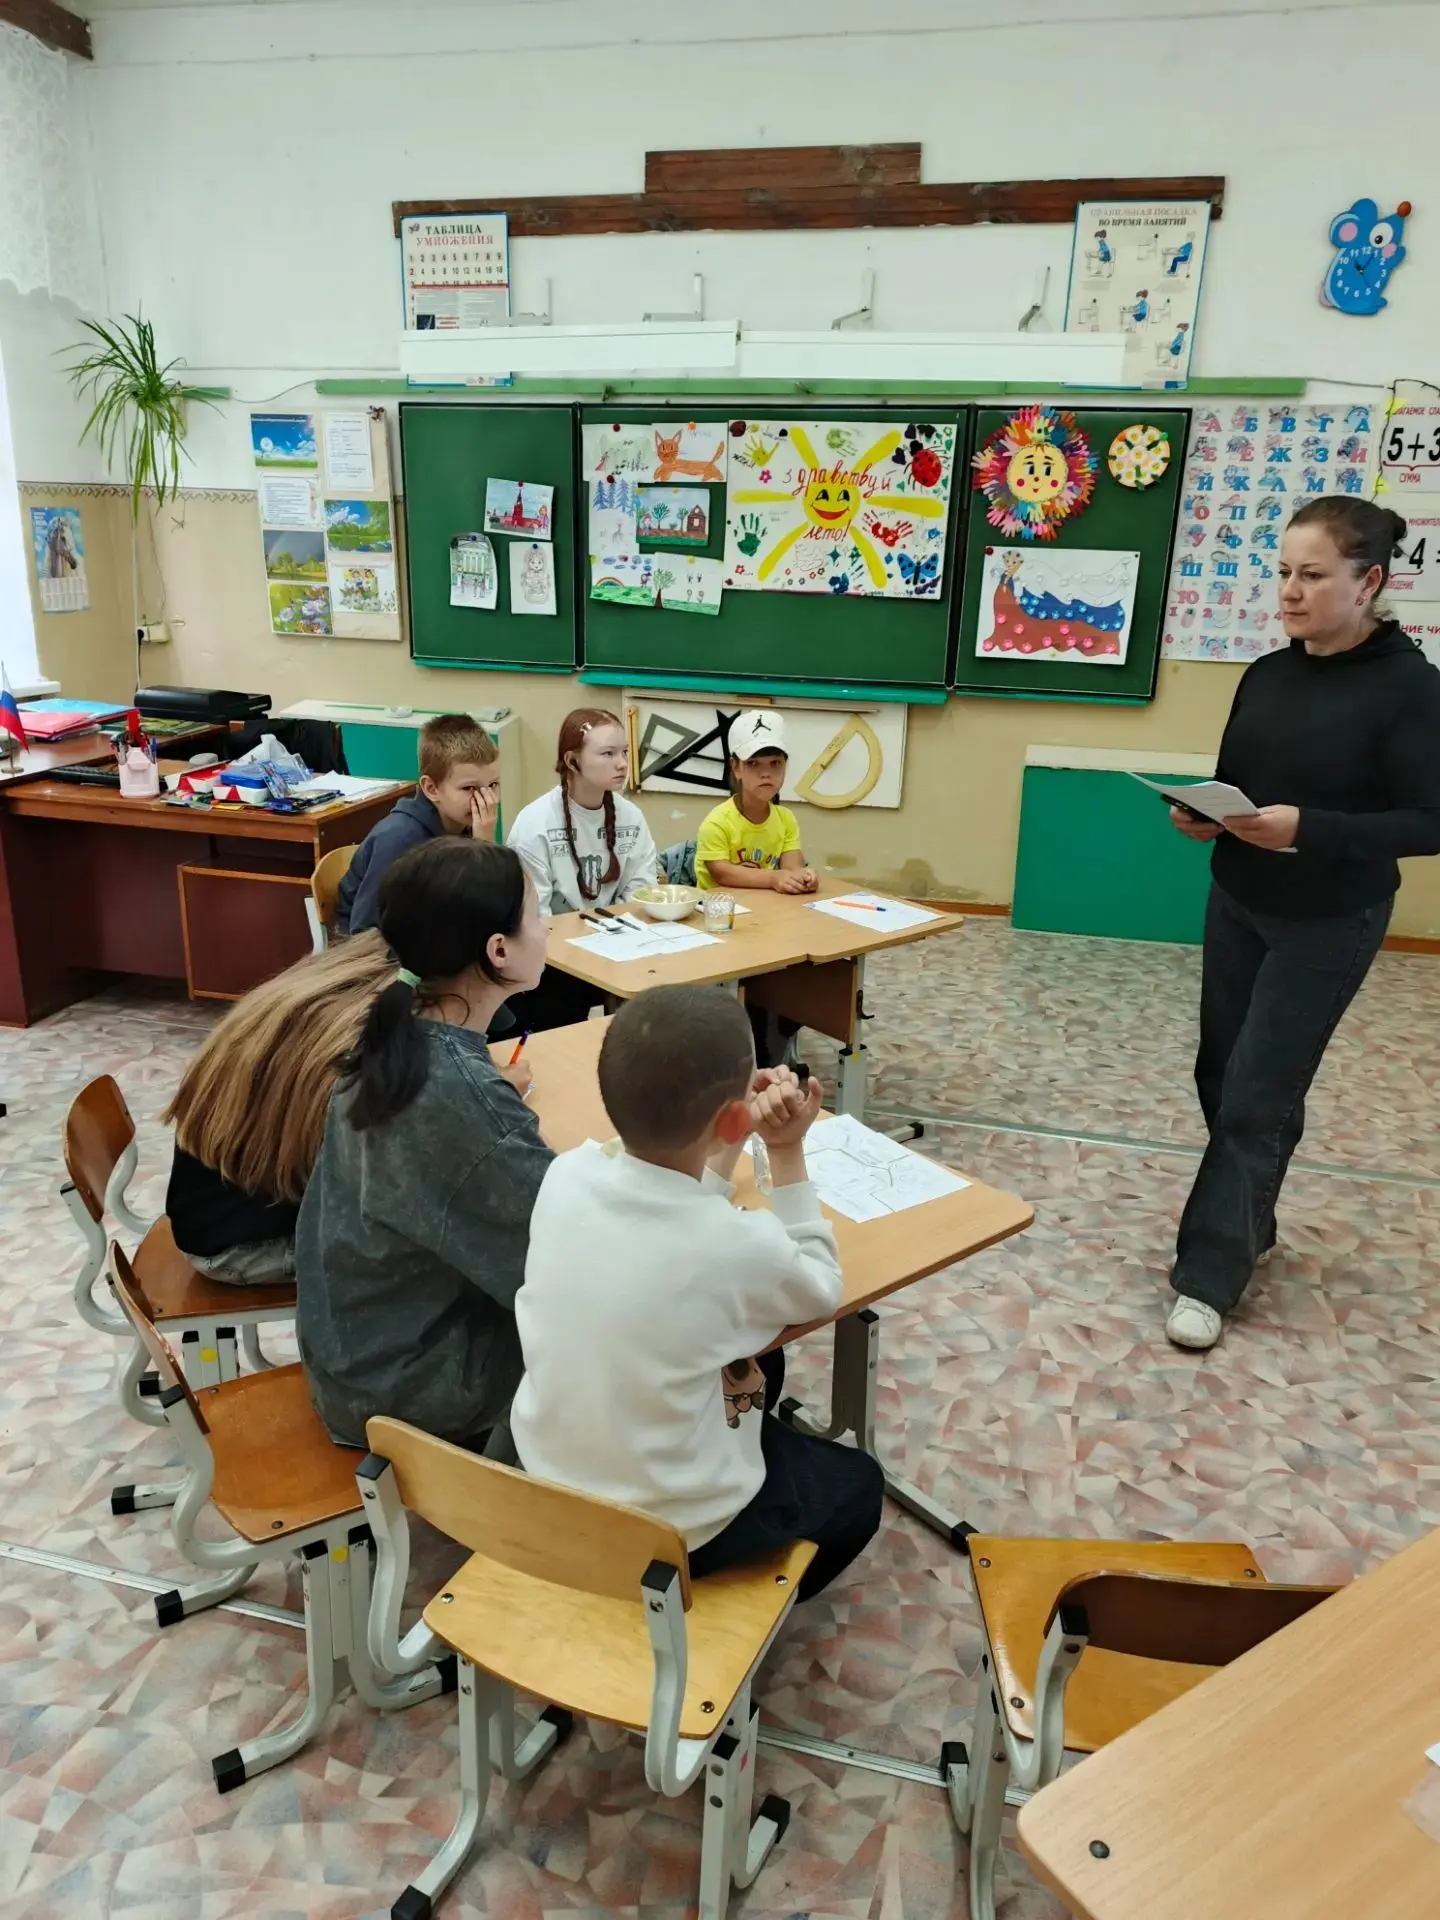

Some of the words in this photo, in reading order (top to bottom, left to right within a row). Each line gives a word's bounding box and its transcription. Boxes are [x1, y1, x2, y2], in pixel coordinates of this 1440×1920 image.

[425, 224, 482, 235] ТАБЛИЦА
[416, 235, 494, 246] УМНОЖЕНИЯ
[1350, 249, 1359, 257] 11
[1361, 246, 1372, 254] 12
[1373, 249, 1378, 258] 1
[1379, 257, 1386, 265] 2
[1336, 268, 1343, 276] 9
[1381, 269, 1387, 277] 3
[1337, 280, 1343, 288] 8
[1374, 280, 1381, 288] 4
[1344, 287, 1350, 295] 7
[1353, 290, 1360, 298] 6
[1205, 415, 1222, 432] А
[1243, 416, 1258, 432] Б
[1280, 416, 1297, 432] В
[1318, 417, 1334, 432] Г
[1354, 418, 1371, 433] Д
[1203, 446, 1217, 461] Е
[1267, 447, 1292, 462] Ж
[1313, 447, 1329, 462] З
[1349, 447, 1368, 463] И
[1197, 472, 1214, 491] Й
[1233, 476, 1250, 491] К
[1270, 476, 1287, 492] Л
[1305, 476, 1326, 492] М
[1344, 477, 1363, 493] Н
[1194, 505, 1210, 520] О
[1230, 505, 1247, 520] П
[1267, 506, 1282, 520] Р
[1191, 533, 1207, 547] У
[1225, 534, 1242, 549] Ф
[1262, 533, 1279, 549] Х
[1408, 538, 1426, 569] 4
[1180, 562, 1203, 577] Ш
[1216, 562, 1239, 578] Щ
[1177, 590, 1199, 604] Ю
[1217, 591, 1233, 605] Я
[1169, 606, 1178, 617] 1
[1203, 608, 1212, 618] 2
[1238, 608, 1246, 619] 3
[1164, 633, 1174, 644] 6
[1200, 635, 1208, 646] 7
[1234, 636, 1243, 646] 8
[1269, 638, 1278, 648] 9
